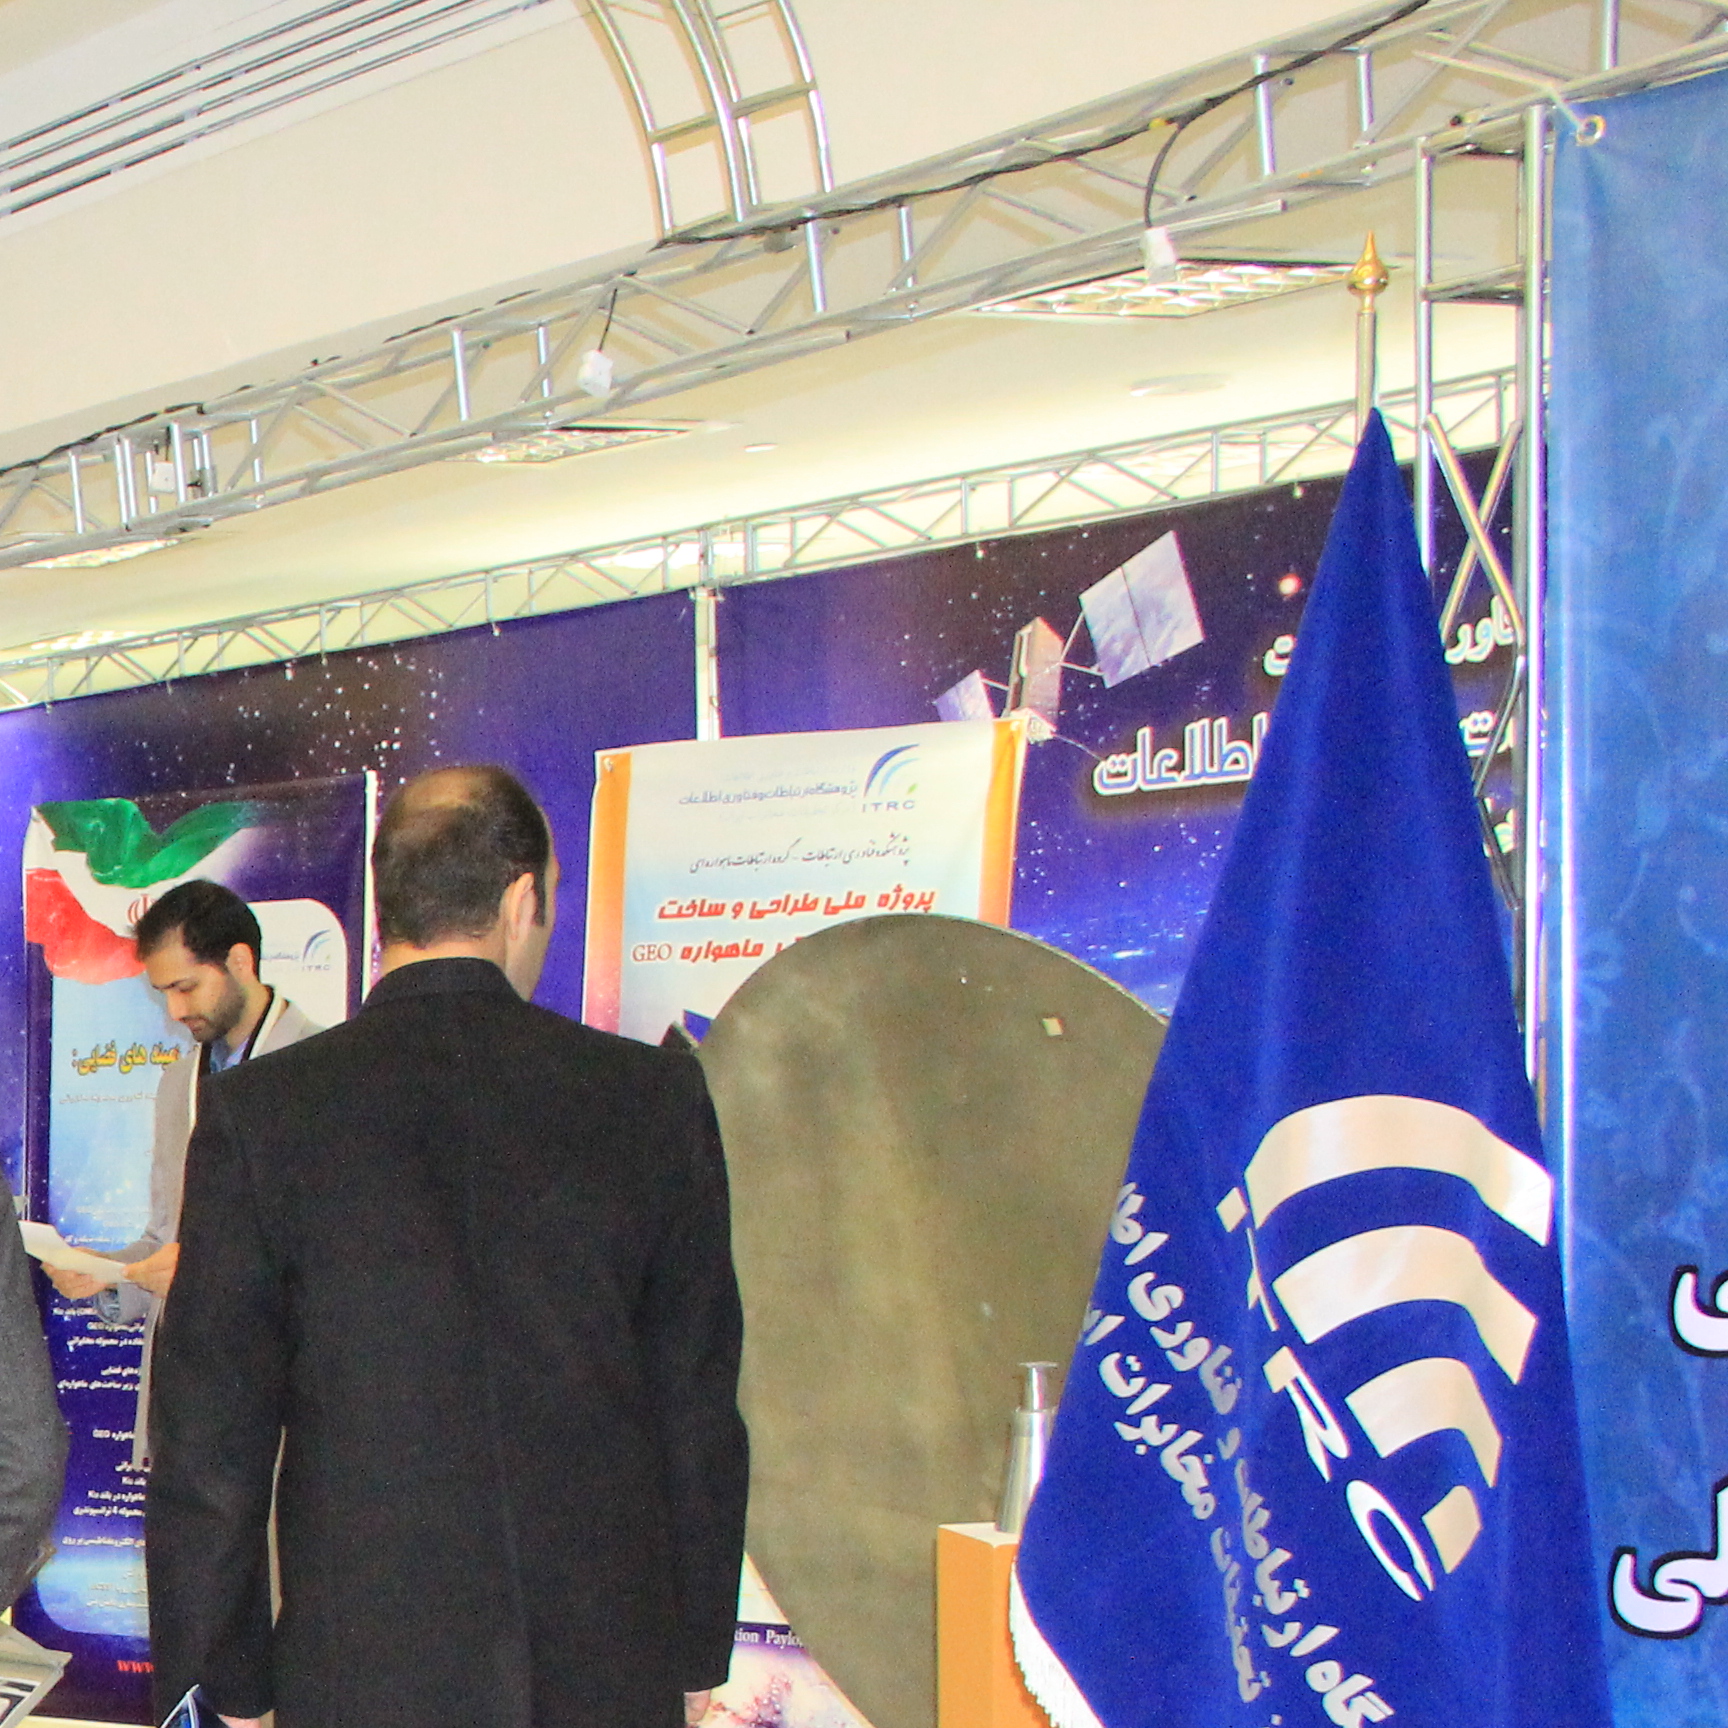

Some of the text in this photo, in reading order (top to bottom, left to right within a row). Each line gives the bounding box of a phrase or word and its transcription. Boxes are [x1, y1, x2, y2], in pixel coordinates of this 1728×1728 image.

[861, 799, 916, 814] ITRC
[656, 884, 936, 921] پروژه ملی طراحی و ساخت
[632, 937, 765, 964] ماهواره GEO
[119, 1042, 148, 1074] های
